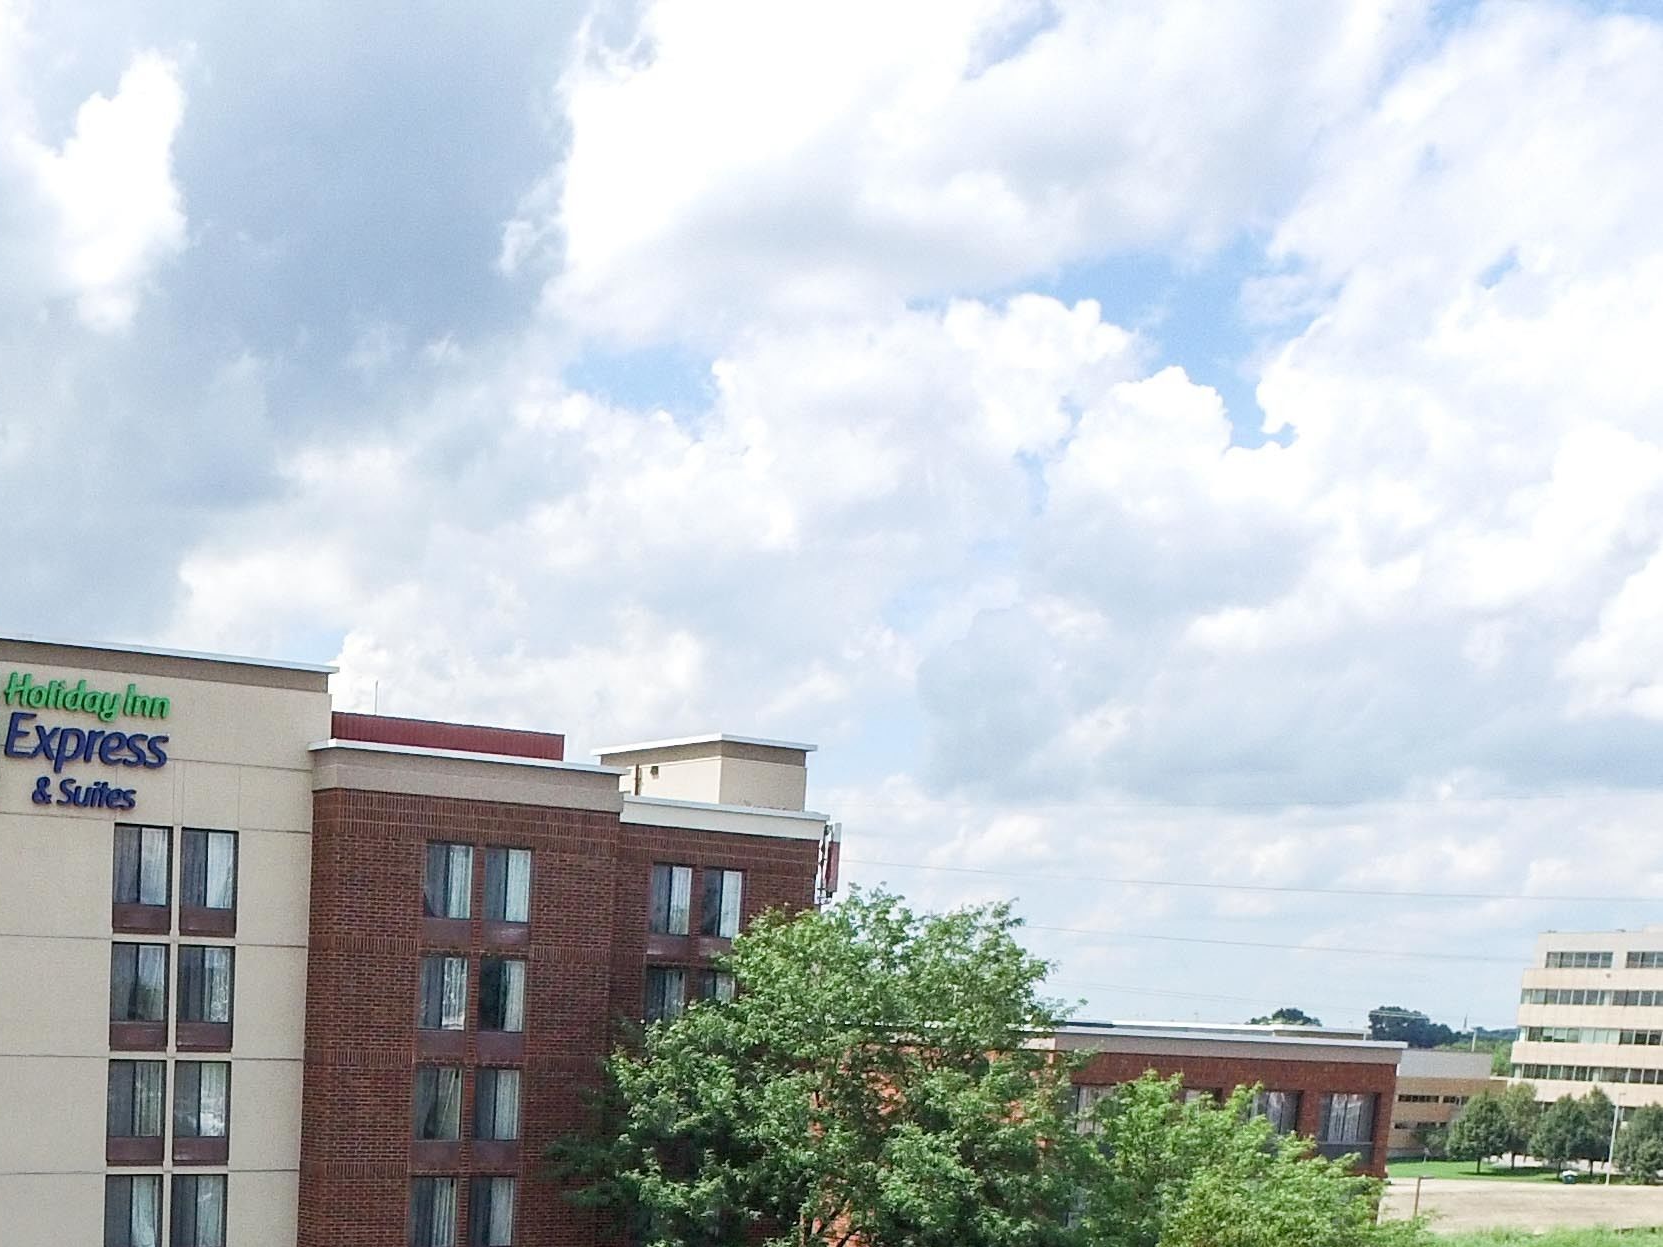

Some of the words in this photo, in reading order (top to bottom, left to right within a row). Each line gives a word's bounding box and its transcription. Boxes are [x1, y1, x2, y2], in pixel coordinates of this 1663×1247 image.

[4, 672, 121, 722] Holiday
[123, 684, 171, 719] Inn
[4, 711, 170, 774] Express
[32, 776, 52, 804] &
[56, 778, 137, 811] Suites
